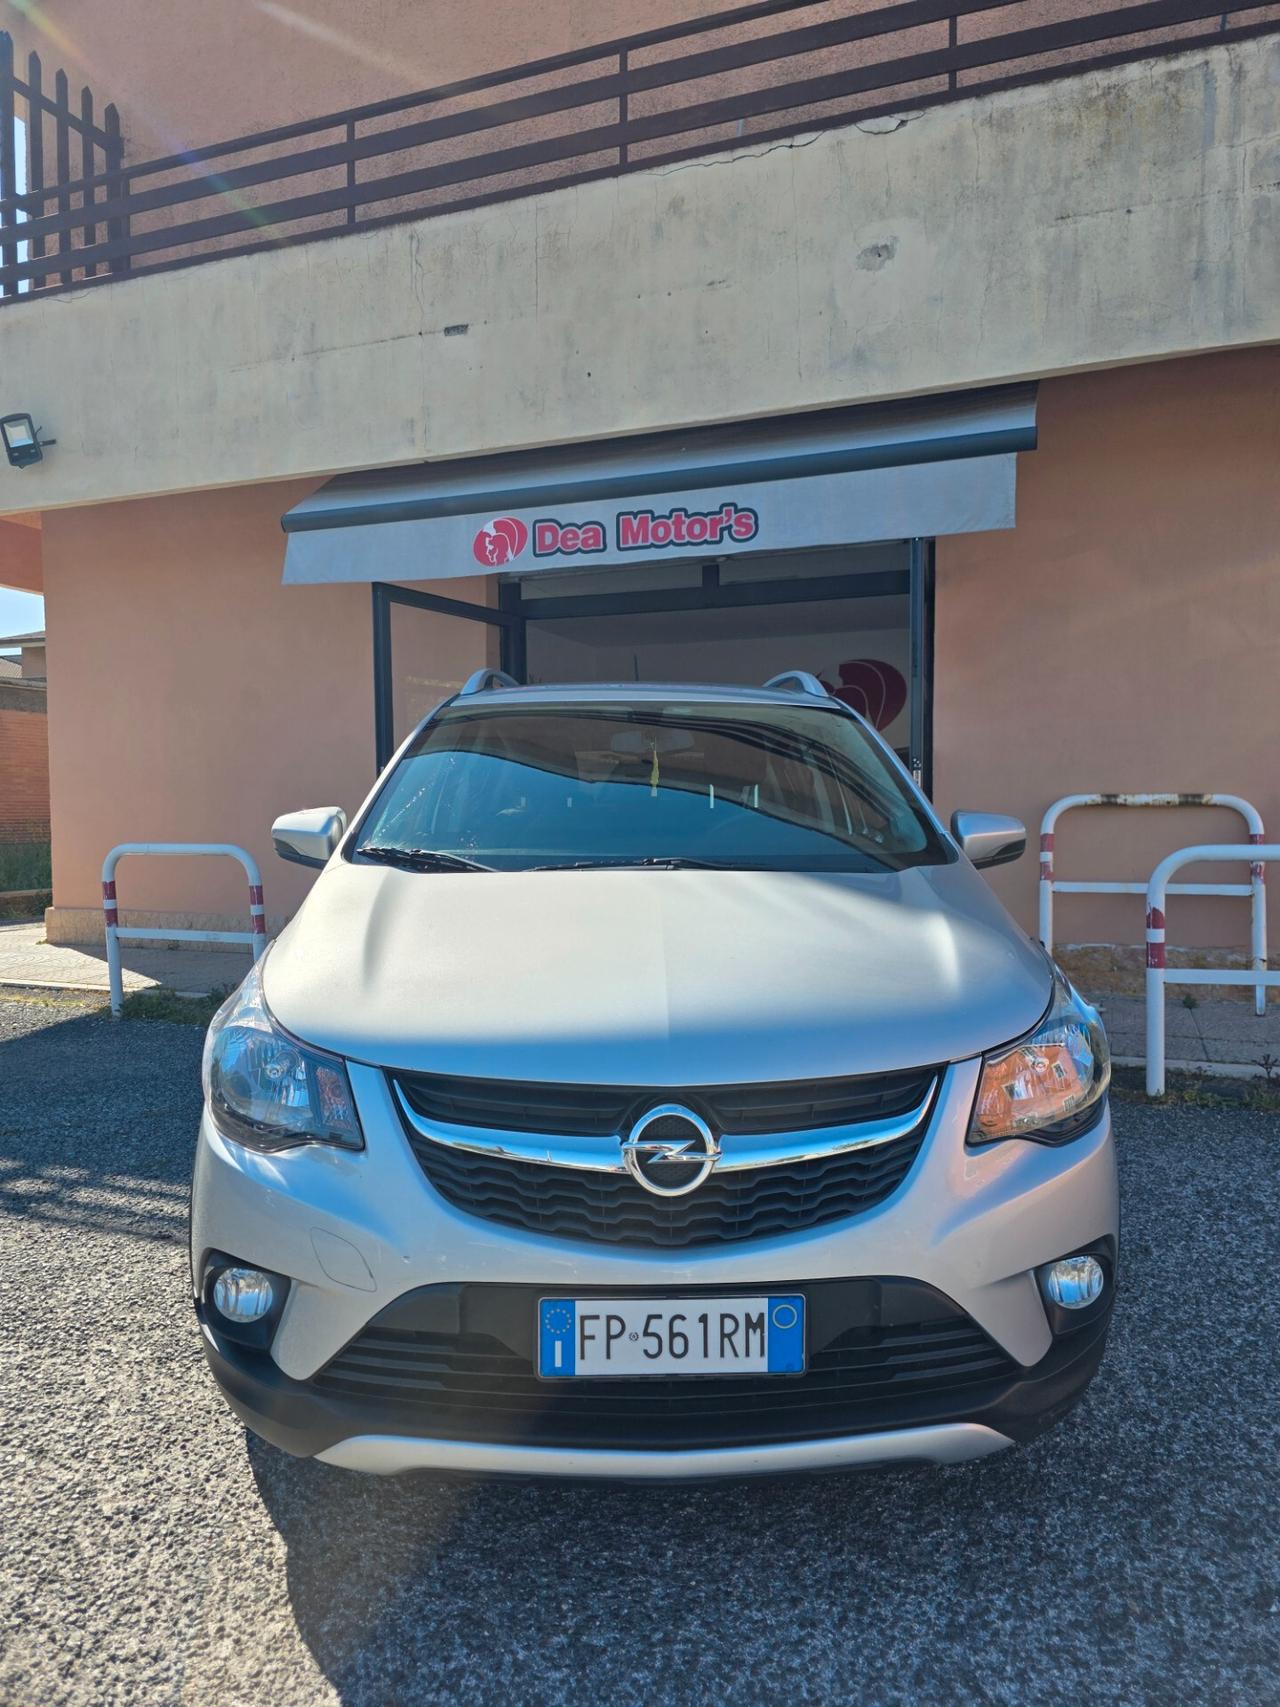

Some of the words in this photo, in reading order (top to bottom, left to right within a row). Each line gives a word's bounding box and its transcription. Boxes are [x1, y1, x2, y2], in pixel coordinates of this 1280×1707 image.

[534, 521, 605, 555] Dea
[618, 504, 756, 548] Motor's
[554, 1340, 562, 1368] I
[579, 1314, 626, 1360] FP
[642, 1312, 765, 1359] 561RM
